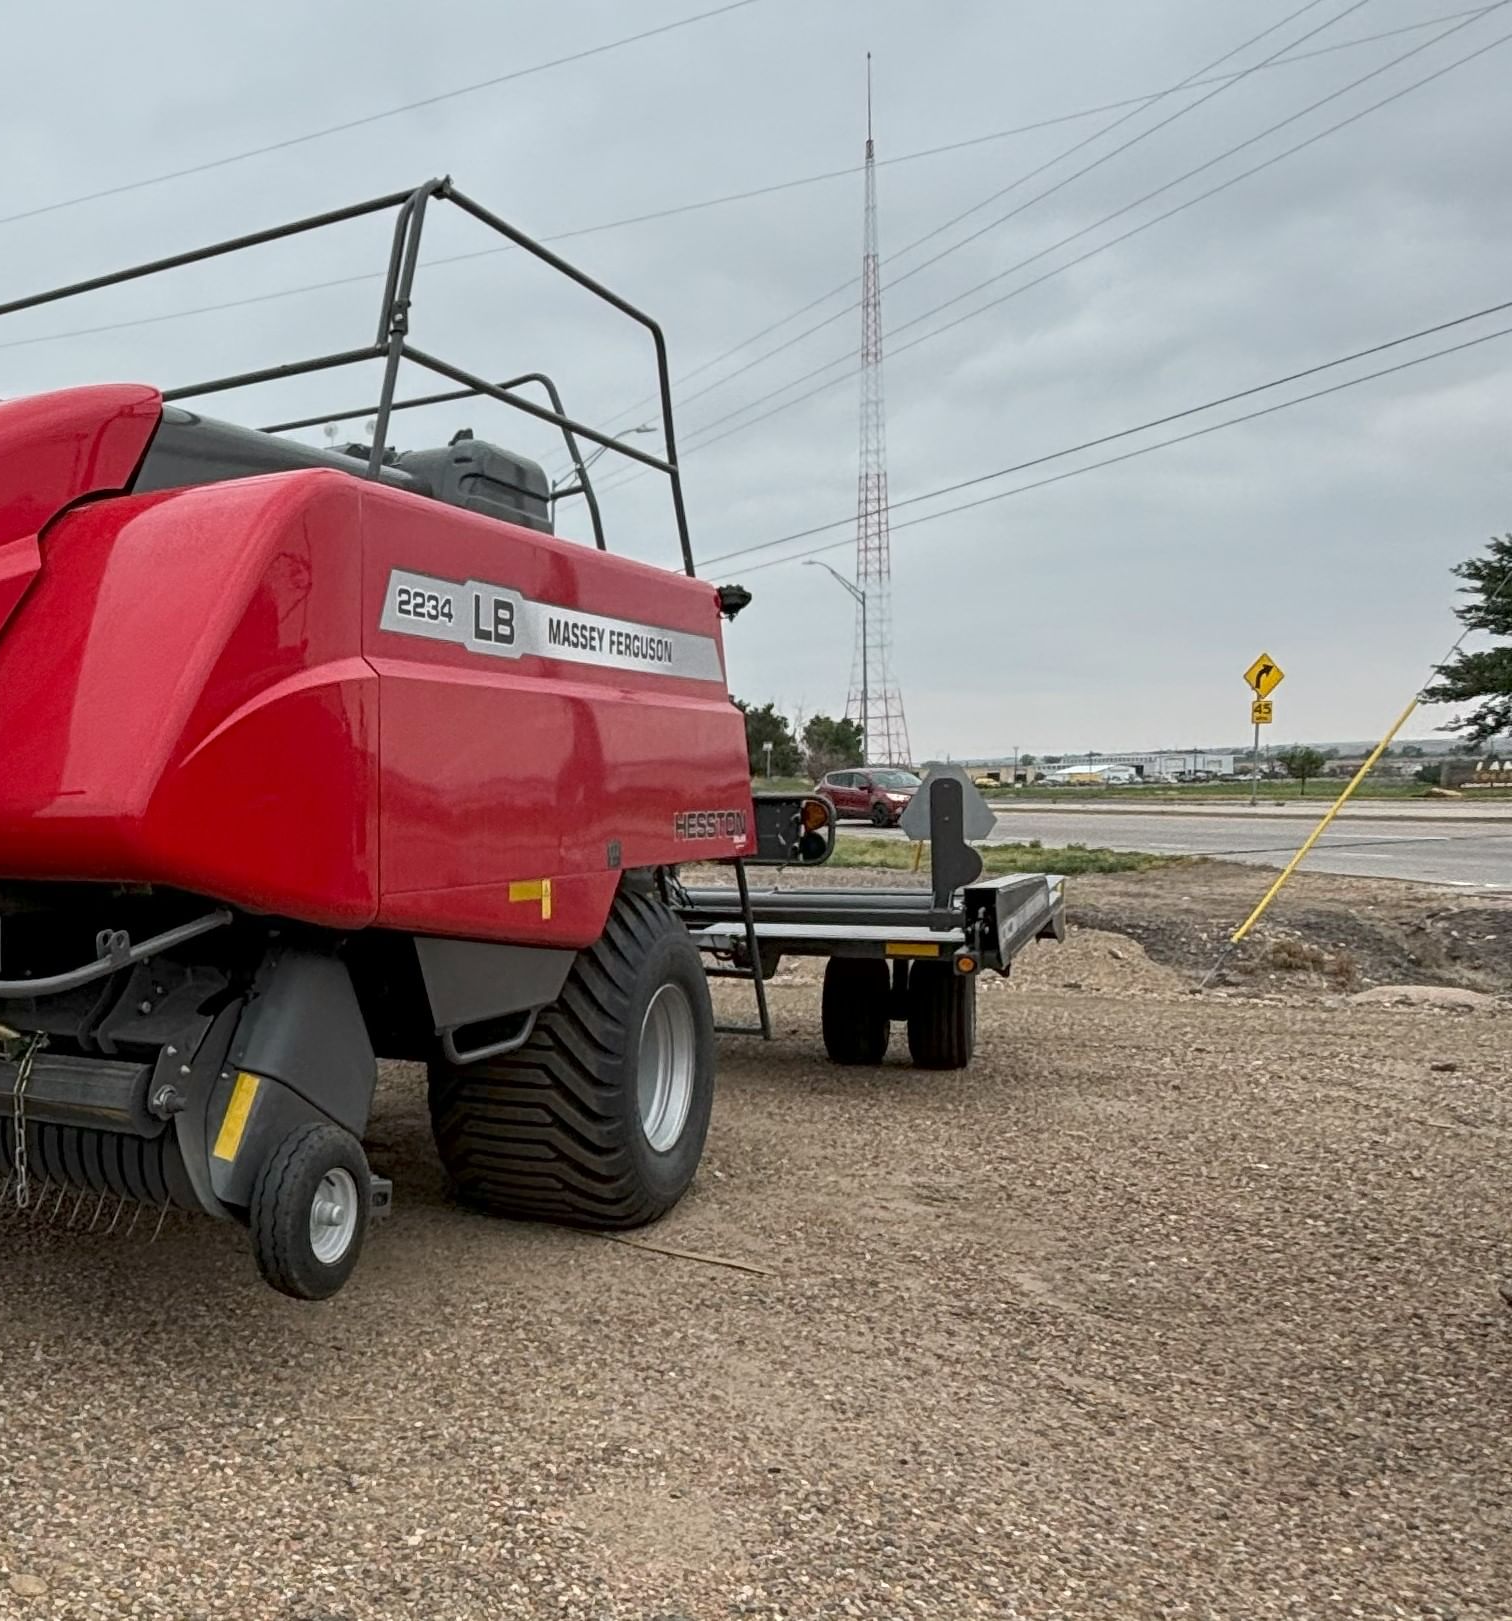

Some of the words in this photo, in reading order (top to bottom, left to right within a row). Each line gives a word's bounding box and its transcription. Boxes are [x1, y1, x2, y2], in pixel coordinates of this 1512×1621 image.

[397, 587, 454, 623] 2234
[474, 594, 515, 645] LB
[548, 617, 606, 652] MASSEY
[608, 629, 673, 663] FERGUSON
[1254, 703, 1272, 715] 45
[674, 811, 746, 841] HESSTON
